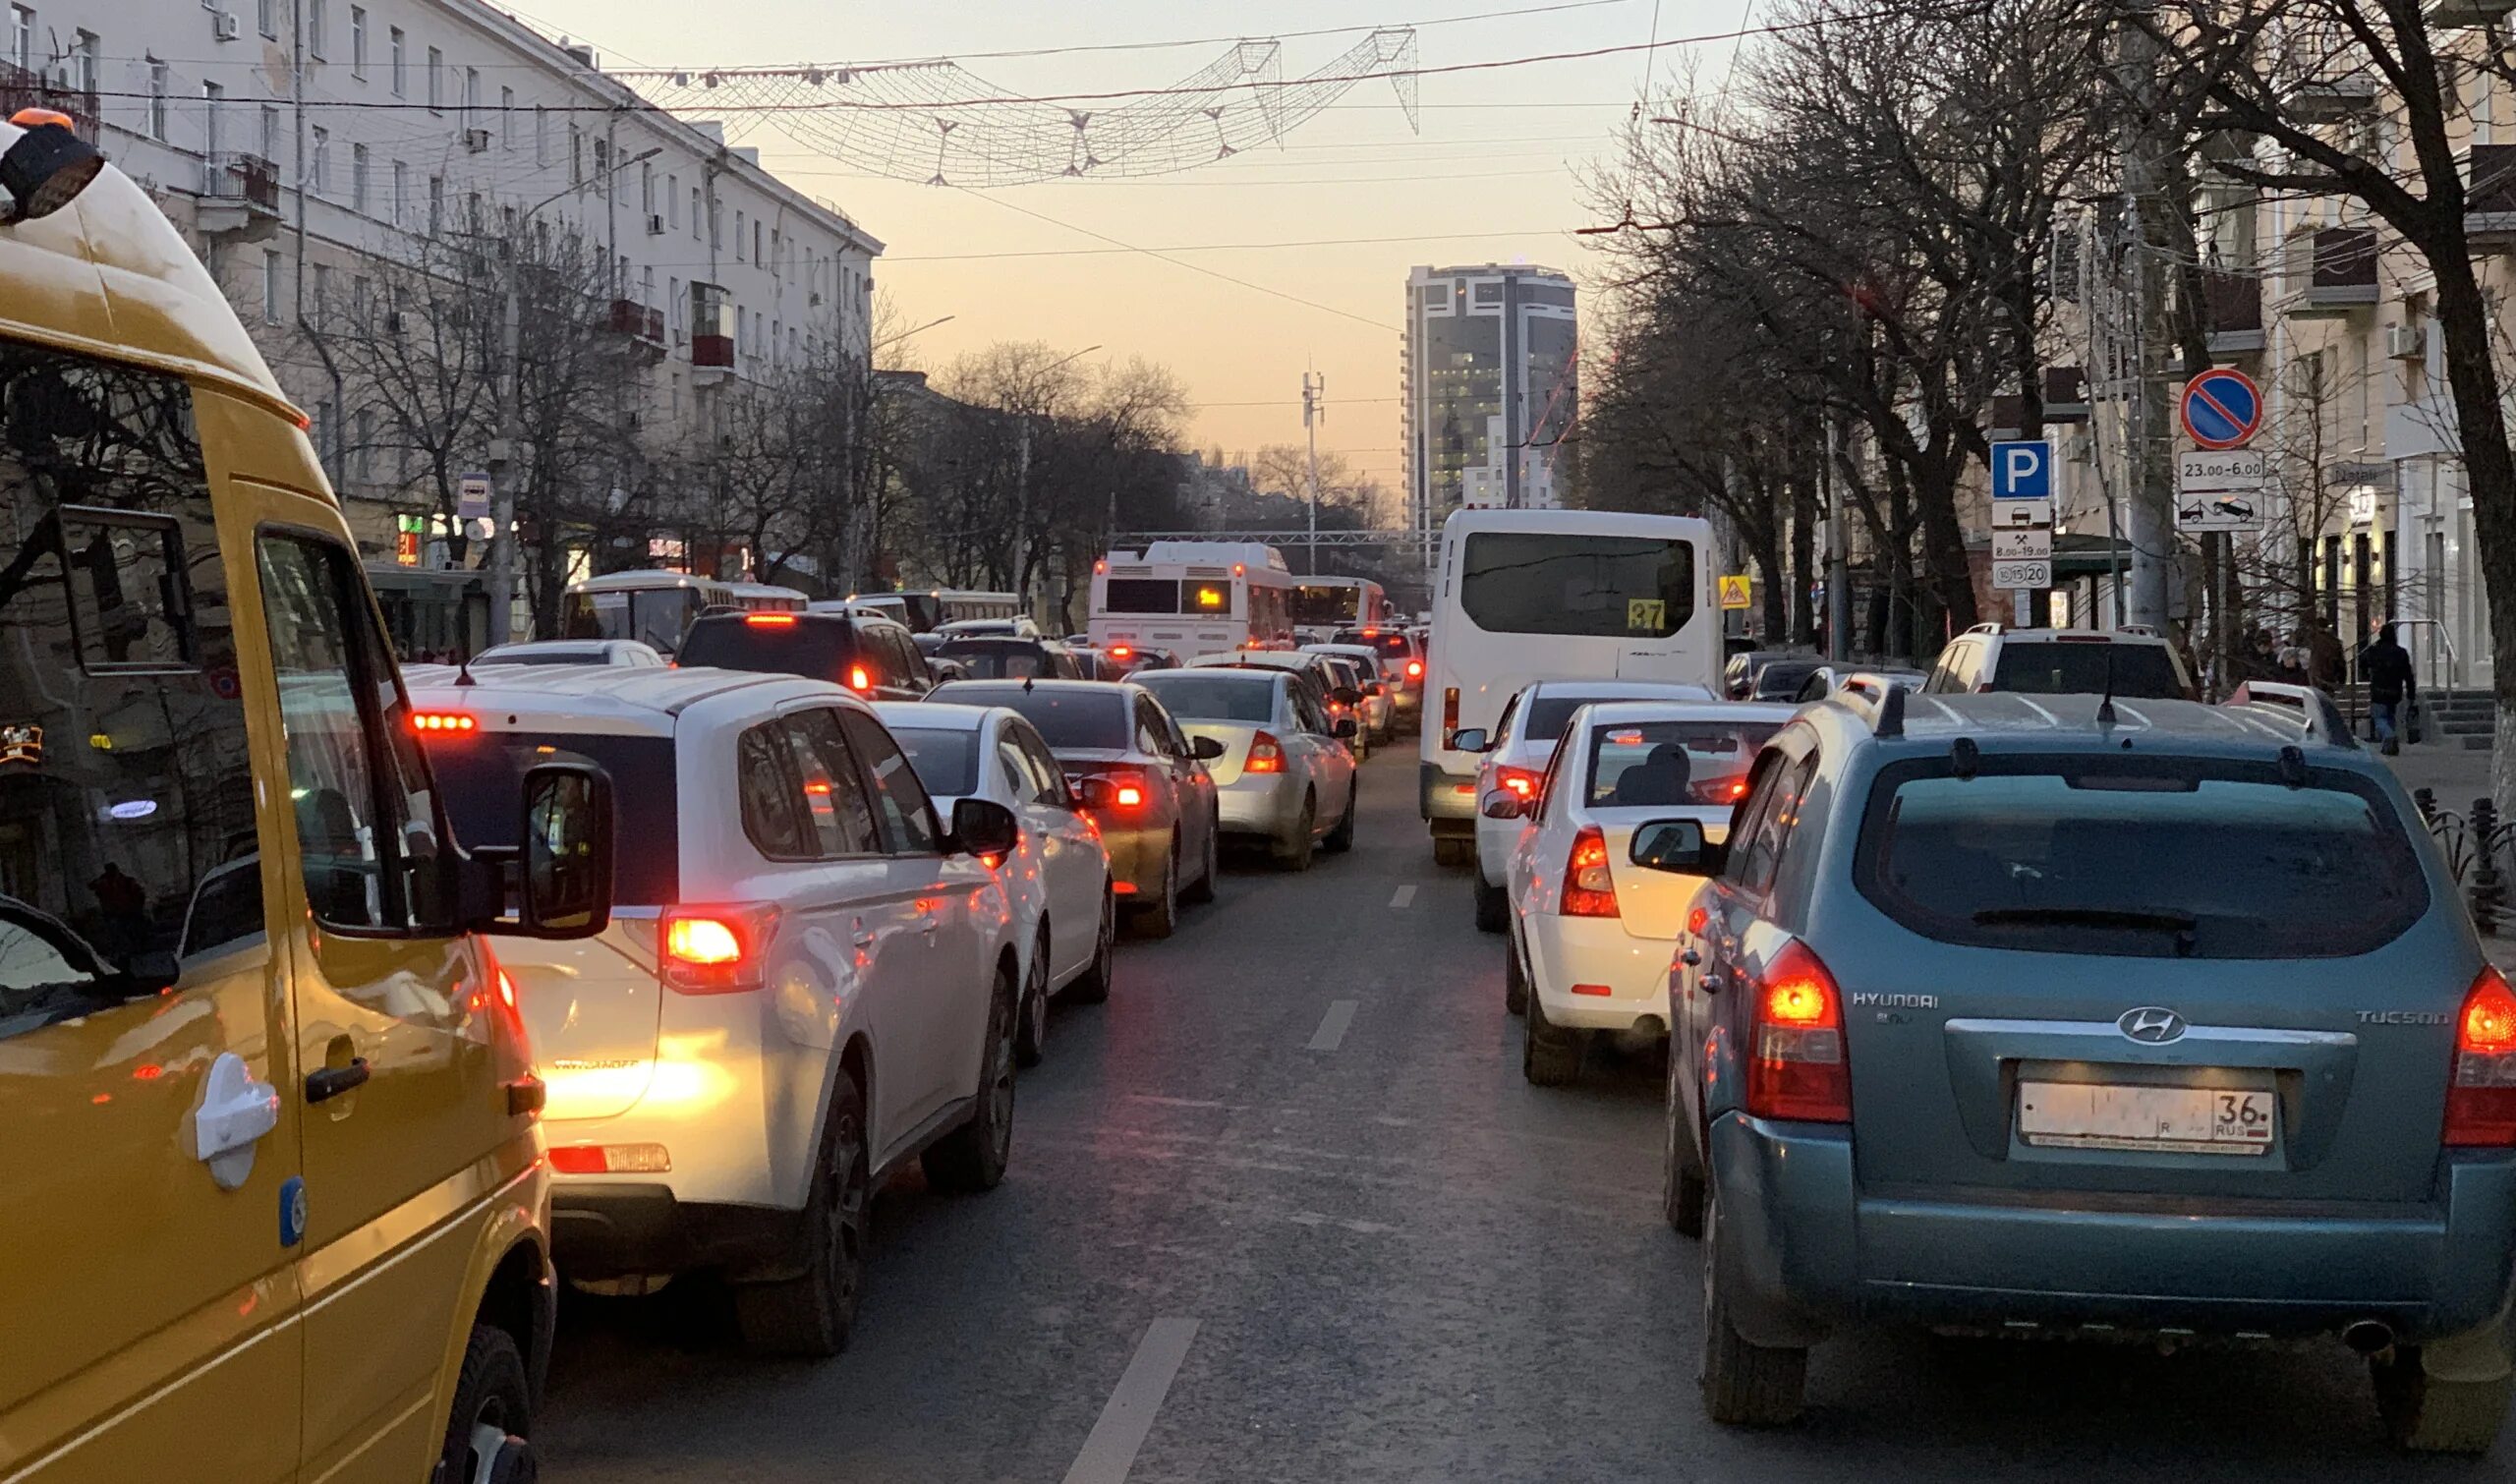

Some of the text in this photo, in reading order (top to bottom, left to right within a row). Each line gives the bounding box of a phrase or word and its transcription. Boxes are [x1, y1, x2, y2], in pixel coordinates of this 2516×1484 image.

[2007, 448, 2039, 493] P
[2185, 462, 2260, 478] 23.00-6.00
[1996, 545, 2048, 557] 8.00-19.00
[2012, 568, 2024, 580] 15
[2028, 567, 2044, 581] 20
[1631, 602, 1662, 630] 37
[1853, 992, 1938, 1009] HYUNDAI
[2218, 1095, 2258, 1124] 36
[2216, 1125, 2246, 1136] RUS
